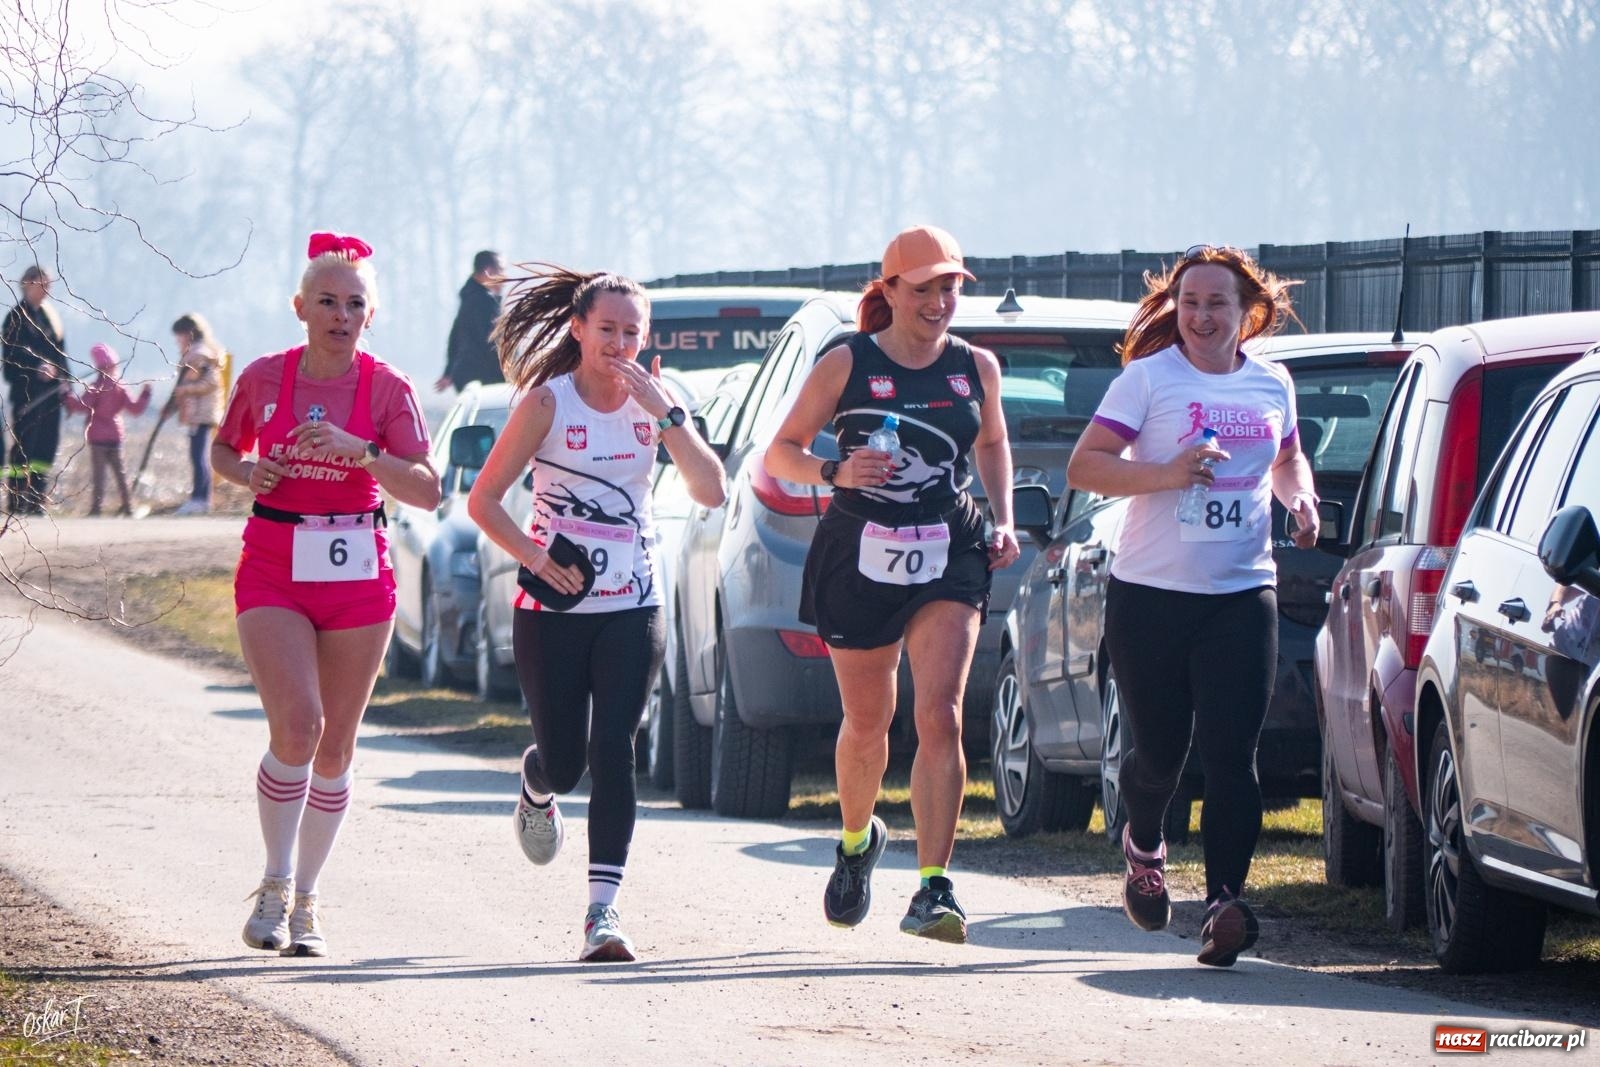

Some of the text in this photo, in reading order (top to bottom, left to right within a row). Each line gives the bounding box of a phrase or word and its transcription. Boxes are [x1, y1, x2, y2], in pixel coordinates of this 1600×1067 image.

[1208, 409, 1249, 424] BIEG
[288, 463, 349, 482] OBIETKI
[1205, 500, 1242, 529] 84
[328, 538, 348, 567] 6
[884, 548, 924, 575] 70
